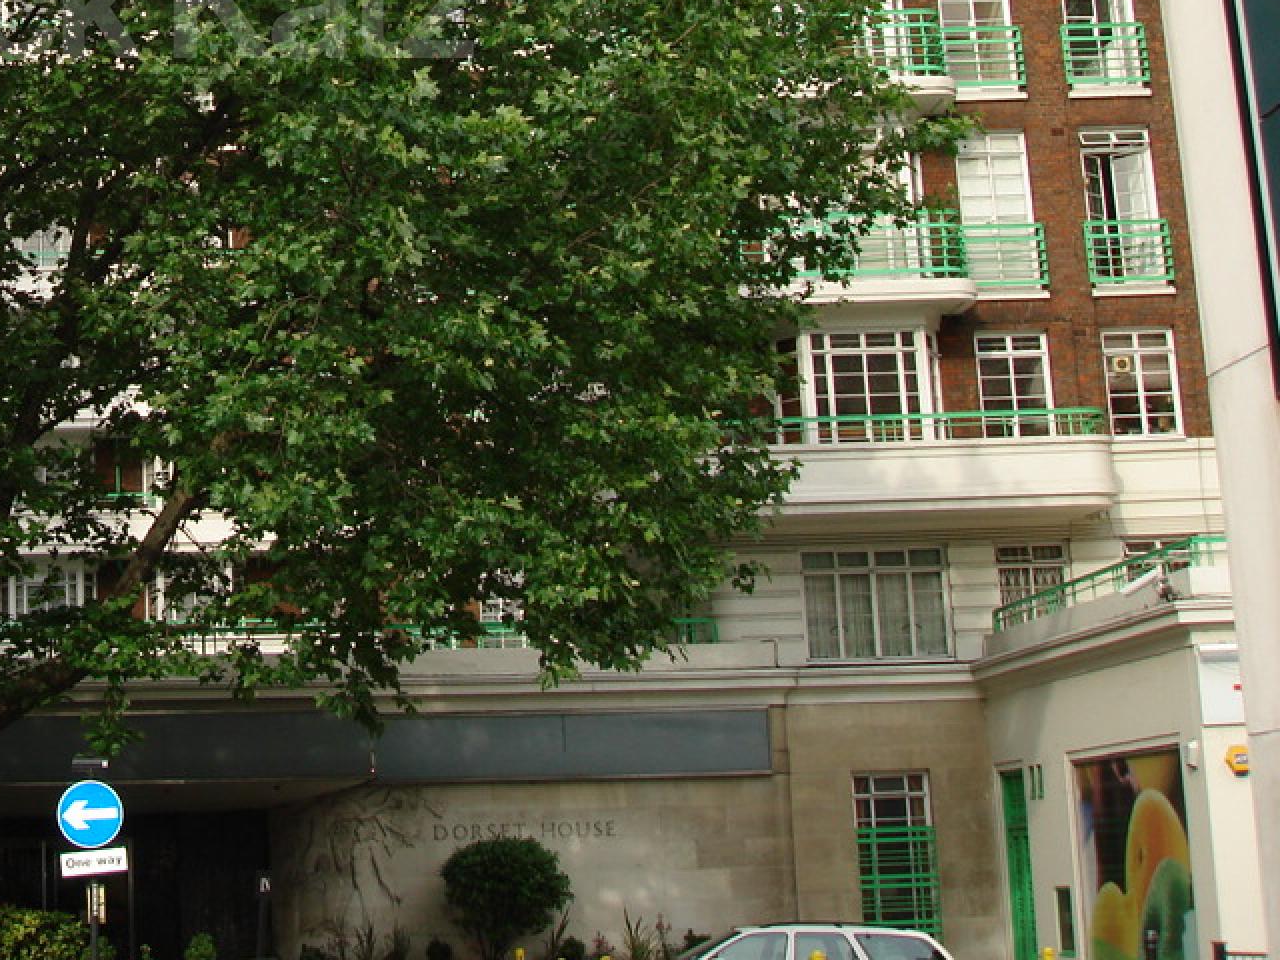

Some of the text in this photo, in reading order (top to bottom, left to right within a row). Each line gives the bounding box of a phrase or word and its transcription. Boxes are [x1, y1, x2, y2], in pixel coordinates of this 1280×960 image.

[432, 820, 617, 841] DORSET HOUSE
[64, 855, 123, 869] One way
